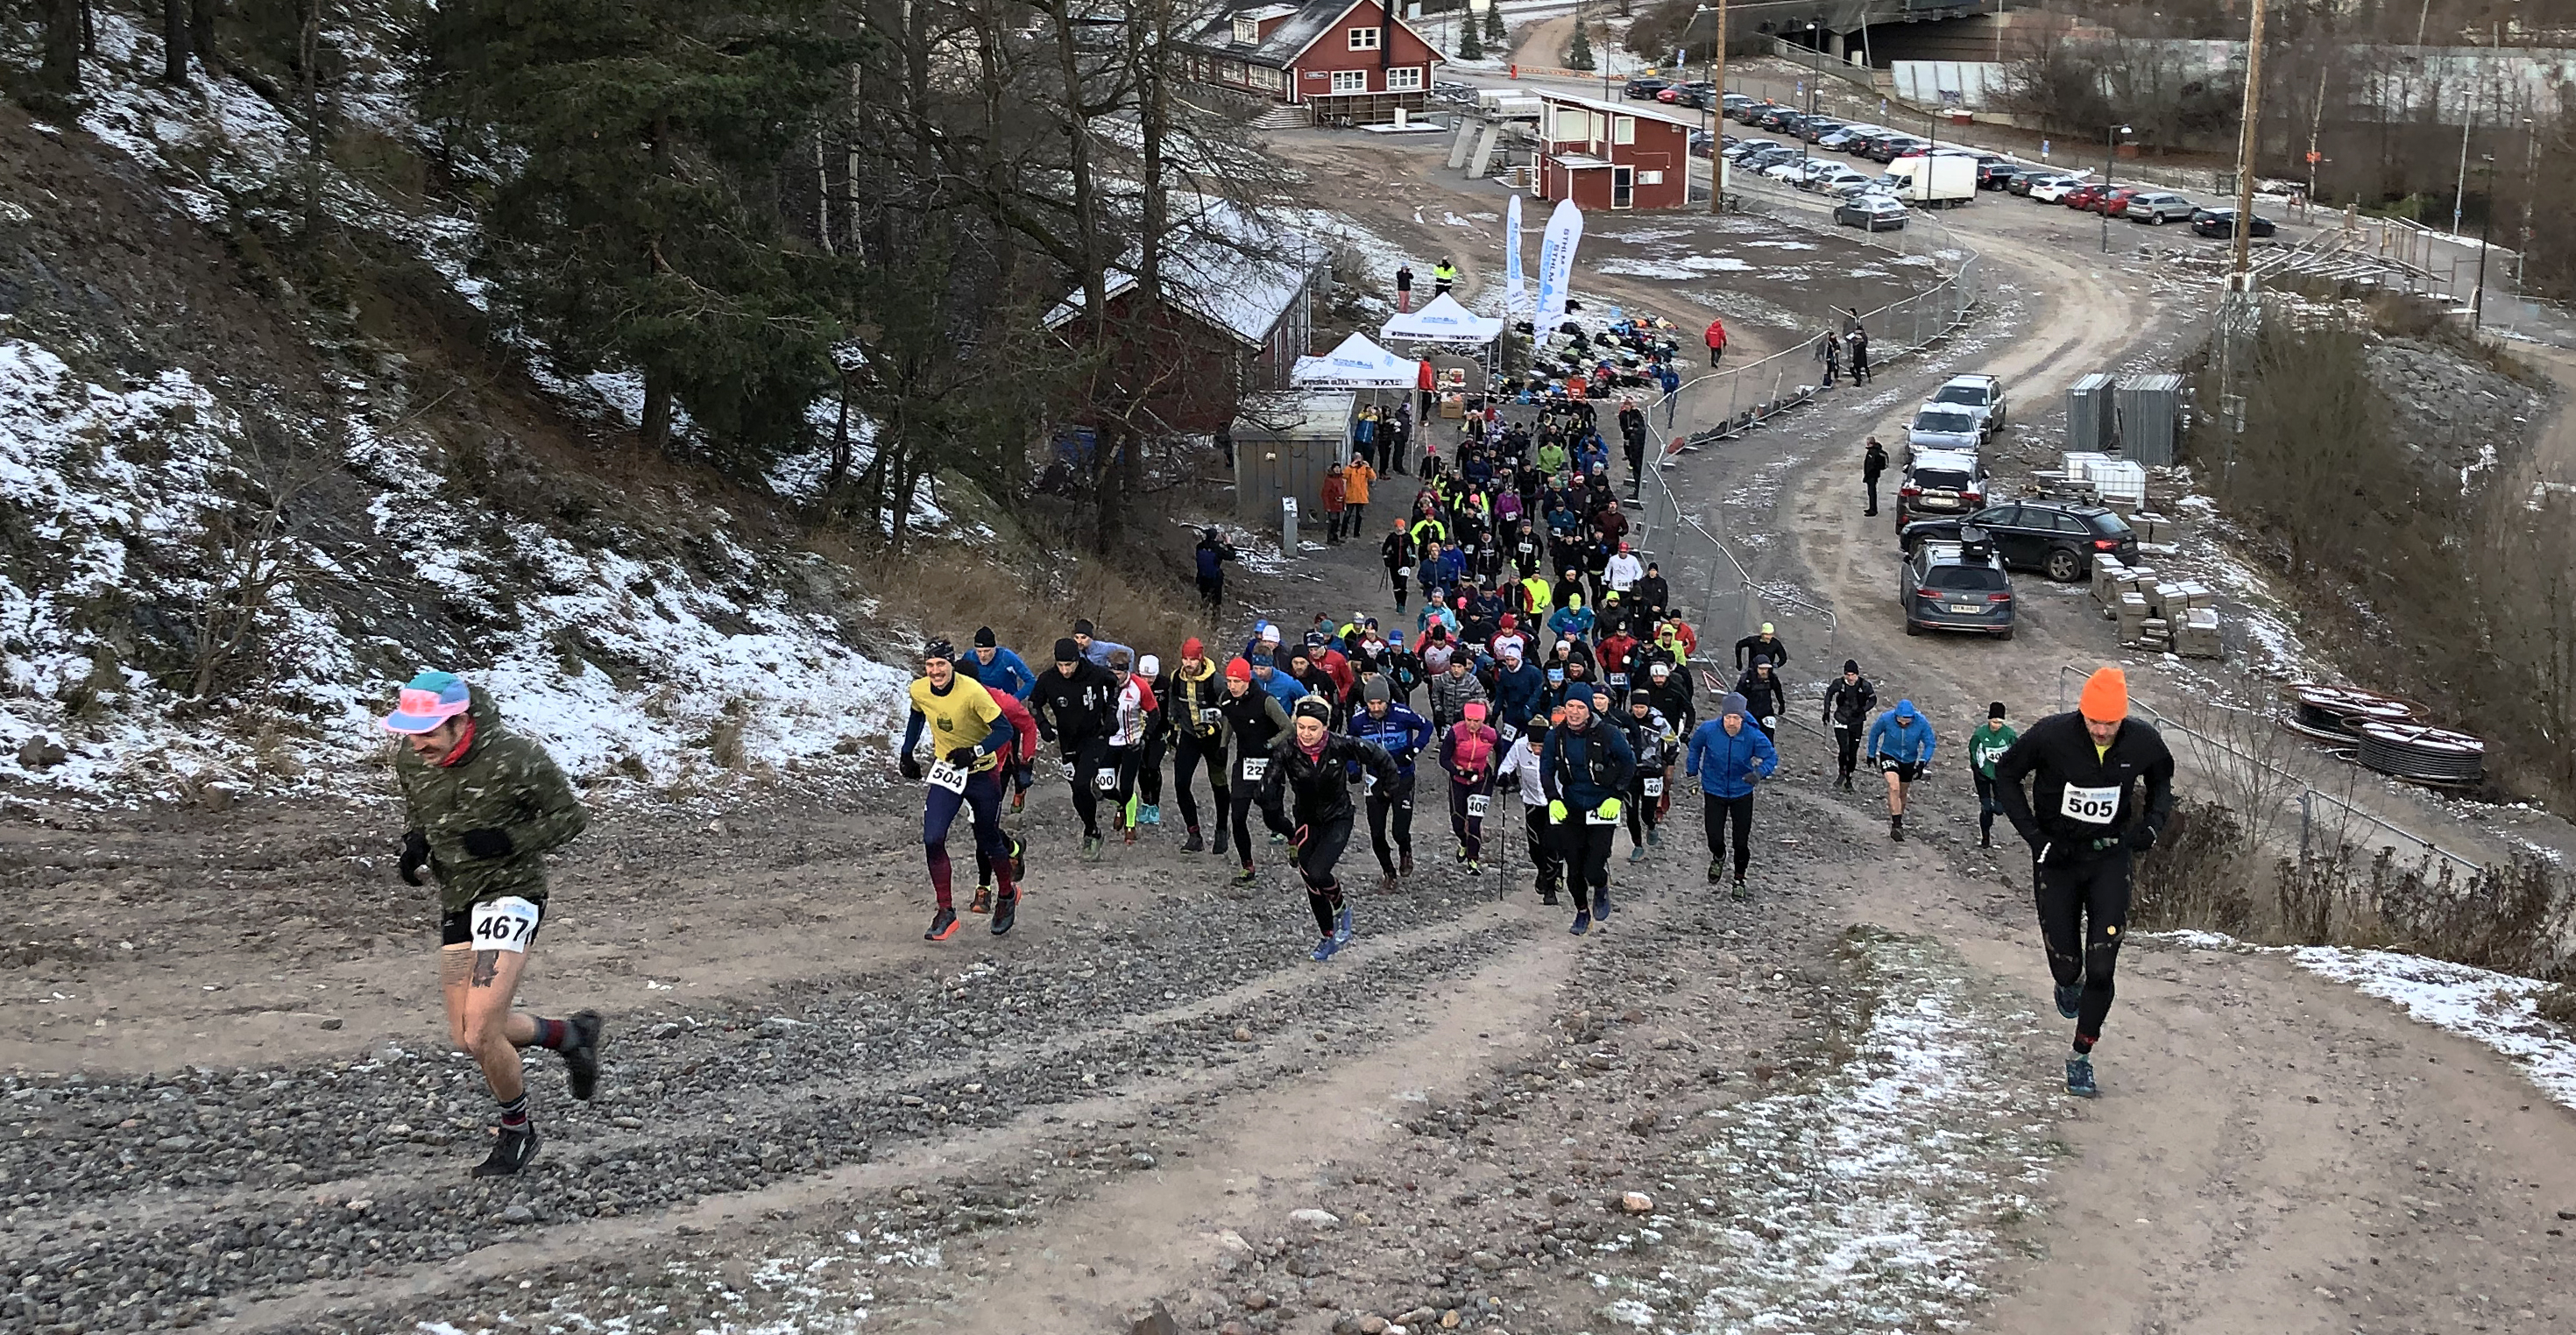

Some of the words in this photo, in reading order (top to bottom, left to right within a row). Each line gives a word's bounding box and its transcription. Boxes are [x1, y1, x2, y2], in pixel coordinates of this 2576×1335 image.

[1547, 244, 1560, 282] STHLM
[932, 767, 963, 788] 504
[2068, 797, 2113, 817] 505
[477, 915, 529, 942] 467
